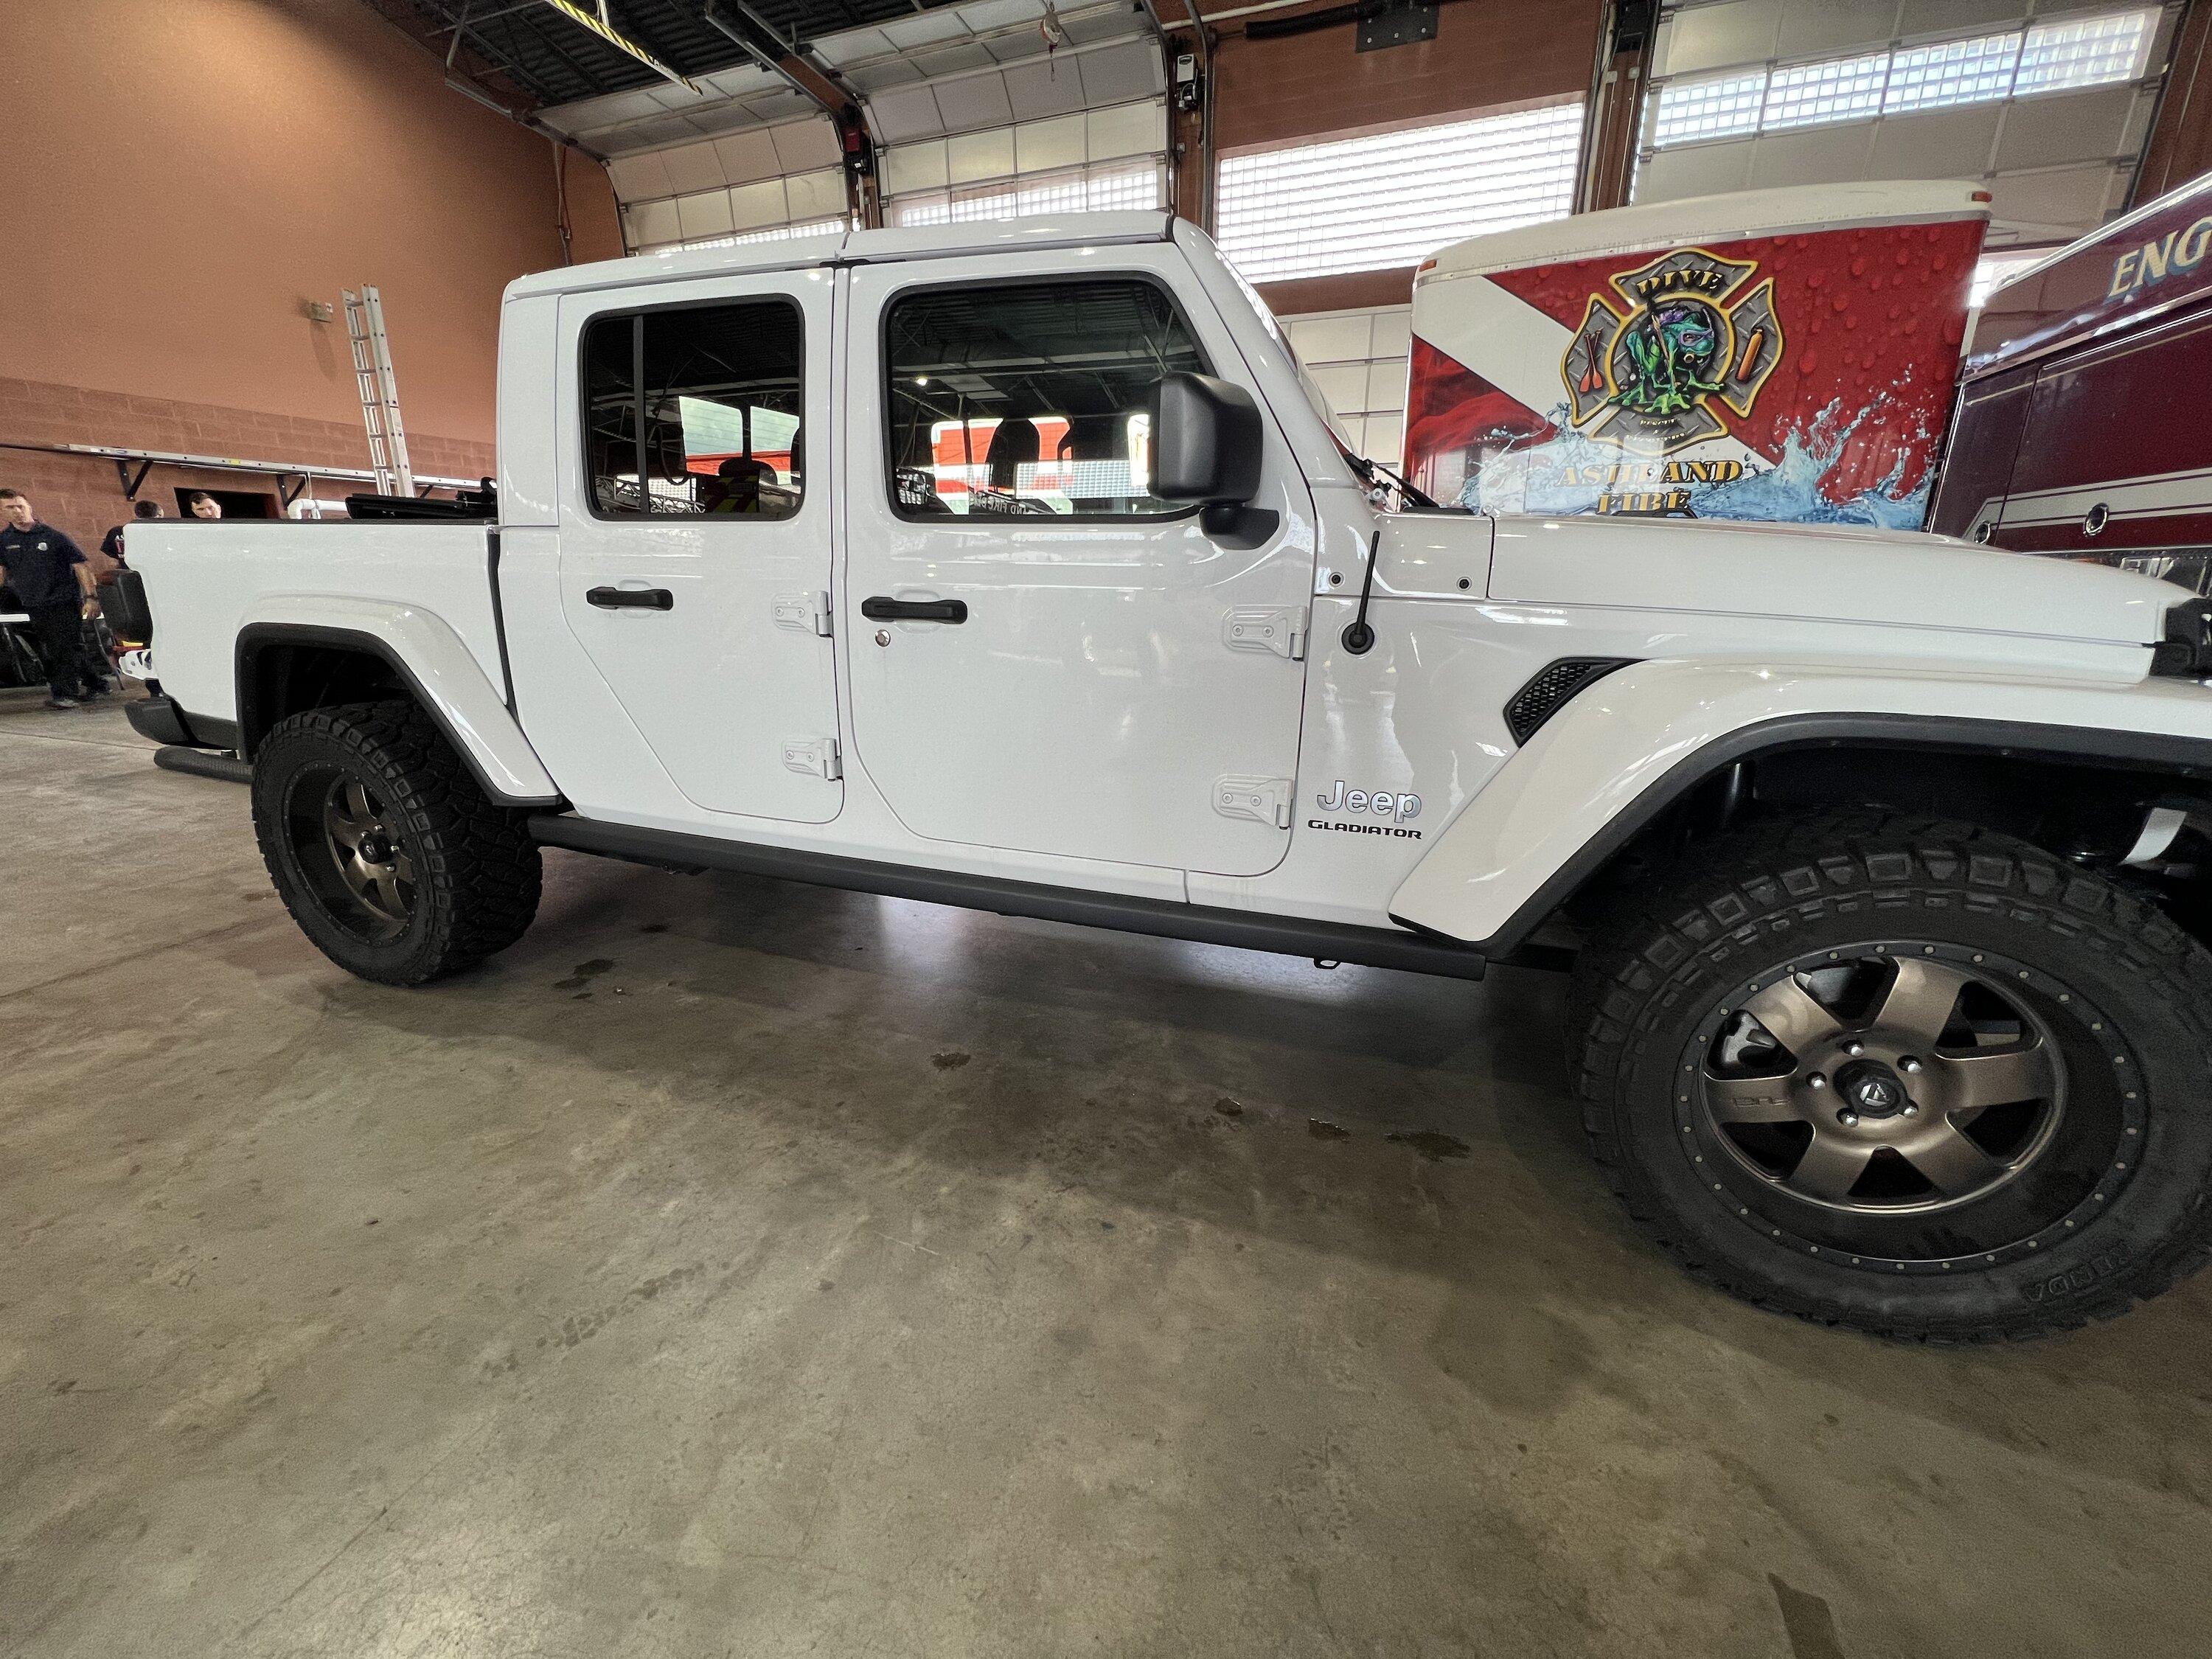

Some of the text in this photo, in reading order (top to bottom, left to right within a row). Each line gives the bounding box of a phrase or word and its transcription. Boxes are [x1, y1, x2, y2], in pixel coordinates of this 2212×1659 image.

[1636, 270, 1722, 294] DIVE
[1554, 460, 1743, 487] ASHLAND
[1596, 491, 1691, 515] FIRE
[1317, 780, 1422, 823] Jeep
[1308, 820, 1422, 839] GLADIATOR
